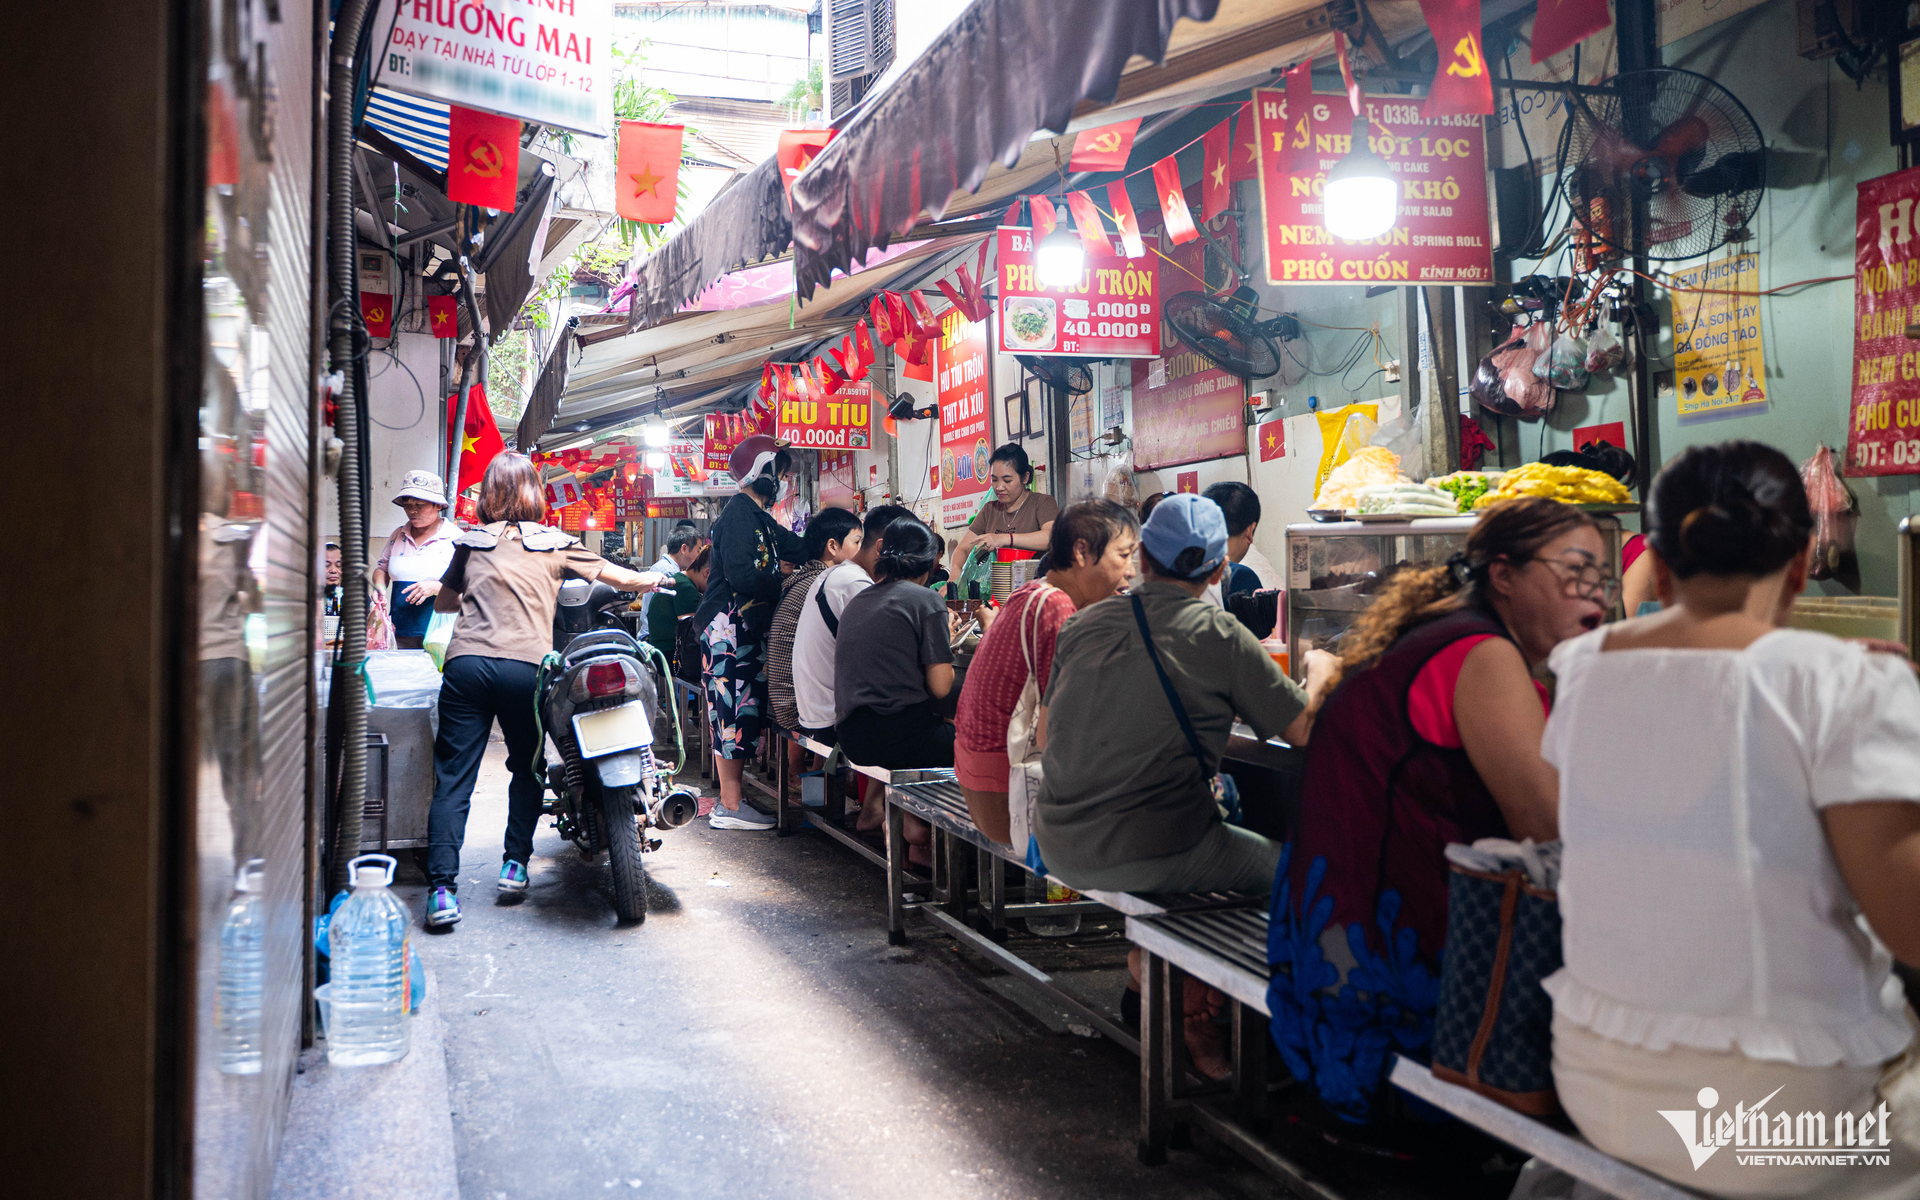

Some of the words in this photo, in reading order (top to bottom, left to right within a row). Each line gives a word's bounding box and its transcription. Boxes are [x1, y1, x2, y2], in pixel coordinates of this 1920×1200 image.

[535, 23, 592, 65] MAI
[389, 53, 410, 76] ĐT:
[392, 28, 429, 52] DẠY
[433, 37, 459, 61] TẠI
[462, 45, 496, 69] NHÀ
[502, 54, 525, 75] TỪ
[526, 61, 556, 83] LỚP
[561, 71, 568, 86] 1
[578, 76, 593, 93] 12
[1419, 137, 1470, 161] LỌC
[1403, 162, 1430, 173] CAKE
[1403, 175, 1460, 200] KHÔ
[1423, 206, 1453, 217] SALAD
[1279, 225, 1335, 246] NEM
[1412, 236, 1454, 248] SPRING
[1457, 236, 1483, 248] ROLL
[1281, 252, 1334, 279] PHỞ
[1340, 251, 1408, 280] CUỐN
[1419, 265, 1454, 279] KÍNH
[1457, 265, 1481, 279] MỜI
[1673, 272, 1697, 288] KEM
[1701, 256, 1756, 282] CHICKEN
[1863, 259, 1903, 299] NỘM
[1096, 262, 1153, 300] TRỘN
[1675, 319, 1690, 335] GÀ
[1710, 310, 1733, 326] SƠN
[1736, 303, 1757, 320] TÂY
[1861, 305, 1907, 341] BÁNH
[1063, 341, 1080, 352] ĐT:
[1676, 338, 1693, 355] GÀ
[1695, 331, 1729, 351] ĐÔNG
[940, 363, 950, 393] HỦ
[951, 361, 962, 389] TÍU
[963, 352, 984, 384] TRỘN
[1858, 354, 1896, 386] NEM
[826, 398, 868, 426] TÍU
[943, 402, 957, 428] THỊT
[959, 393, 969, 421] XÁ
[970, 388, 984, 417] XÍU
[1684, 402, 1700, 412] Ship
[1725, 394, 1739, 405] 24/7
[1855, 390, 1891, 432] PHỞ
[1211, 412, 1237, 433] CHIẾU
